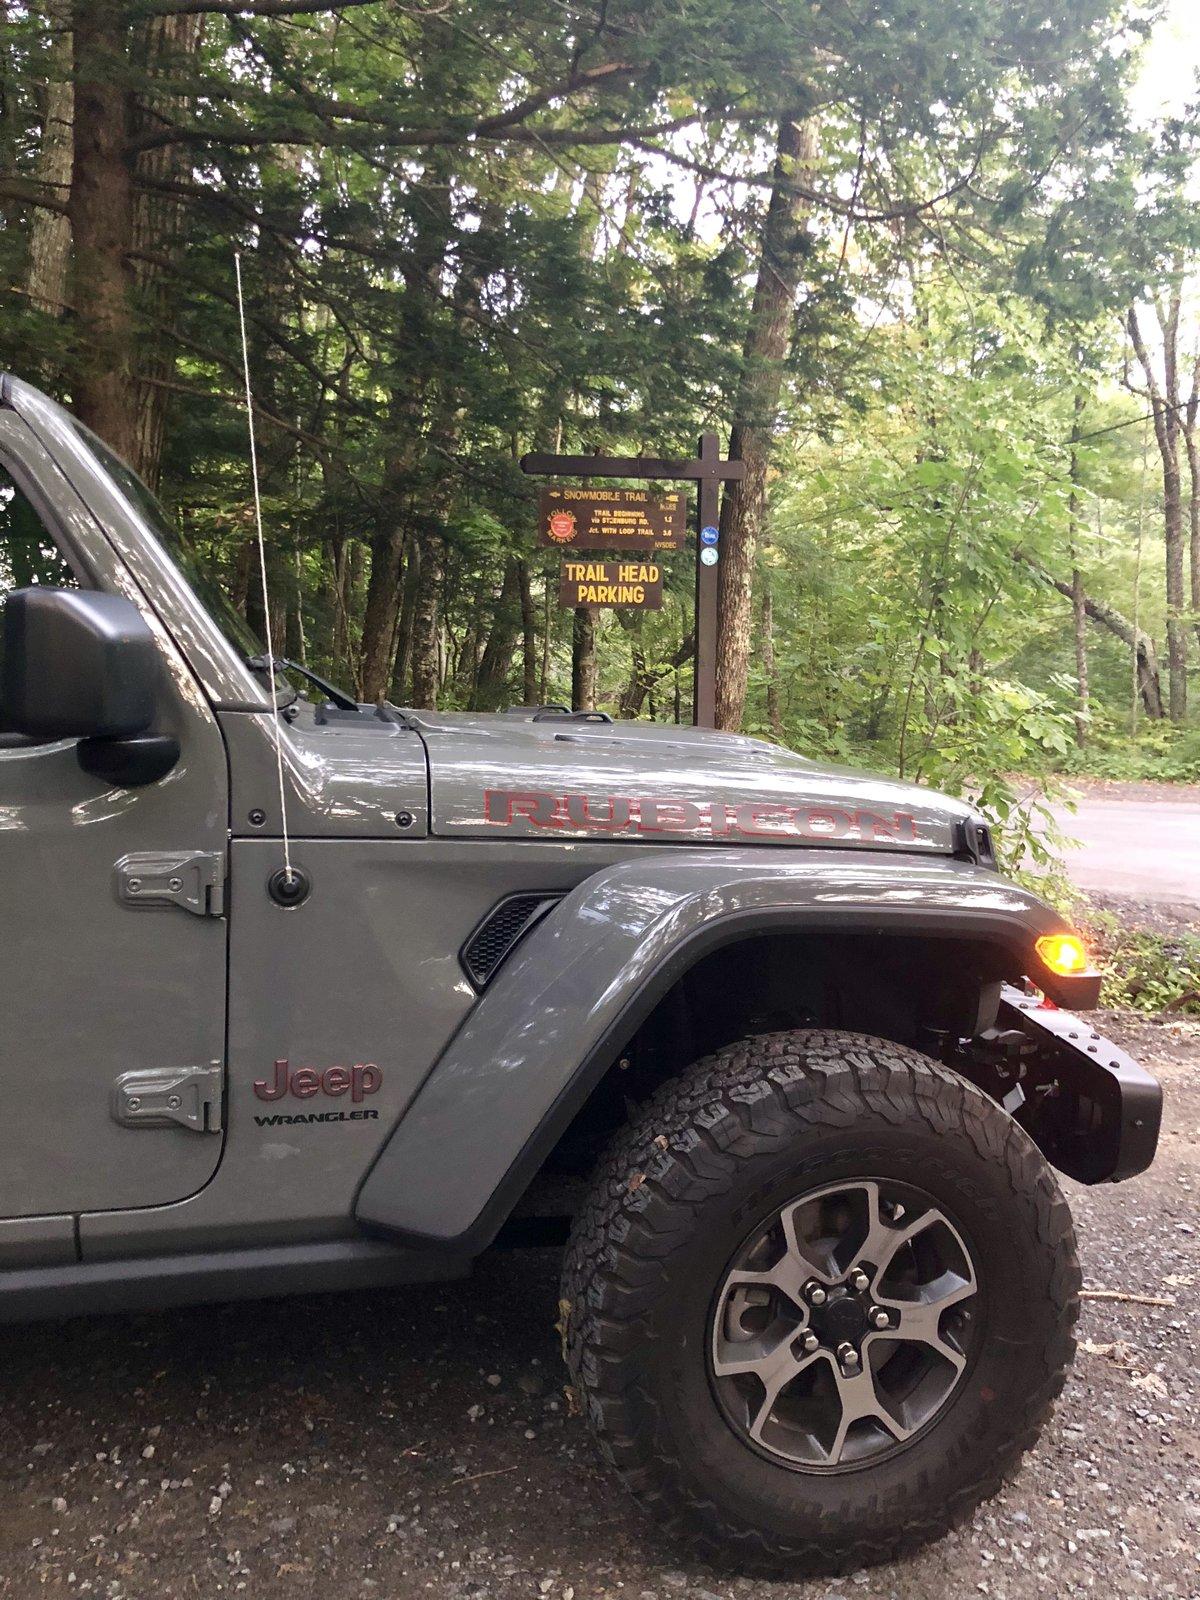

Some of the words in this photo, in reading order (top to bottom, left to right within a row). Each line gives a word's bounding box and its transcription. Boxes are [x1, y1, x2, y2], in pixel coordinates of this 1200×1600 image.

[564, 491, 620, 502] SNOWMOBILE
[625, 492, 648, 502] TRAIL
[613, 510, 645, 518] BEGINNING
[565, 564, 609, 582] TRAIL
[618, 564, 659, 583] HEAD
[578, 585, 645, 604] PARKING
[484, 789, 916, 841] RUBICON
[254, 1059, 383, 1103] Jeep
[253, 1109, 379, 1127] WRANGLER
